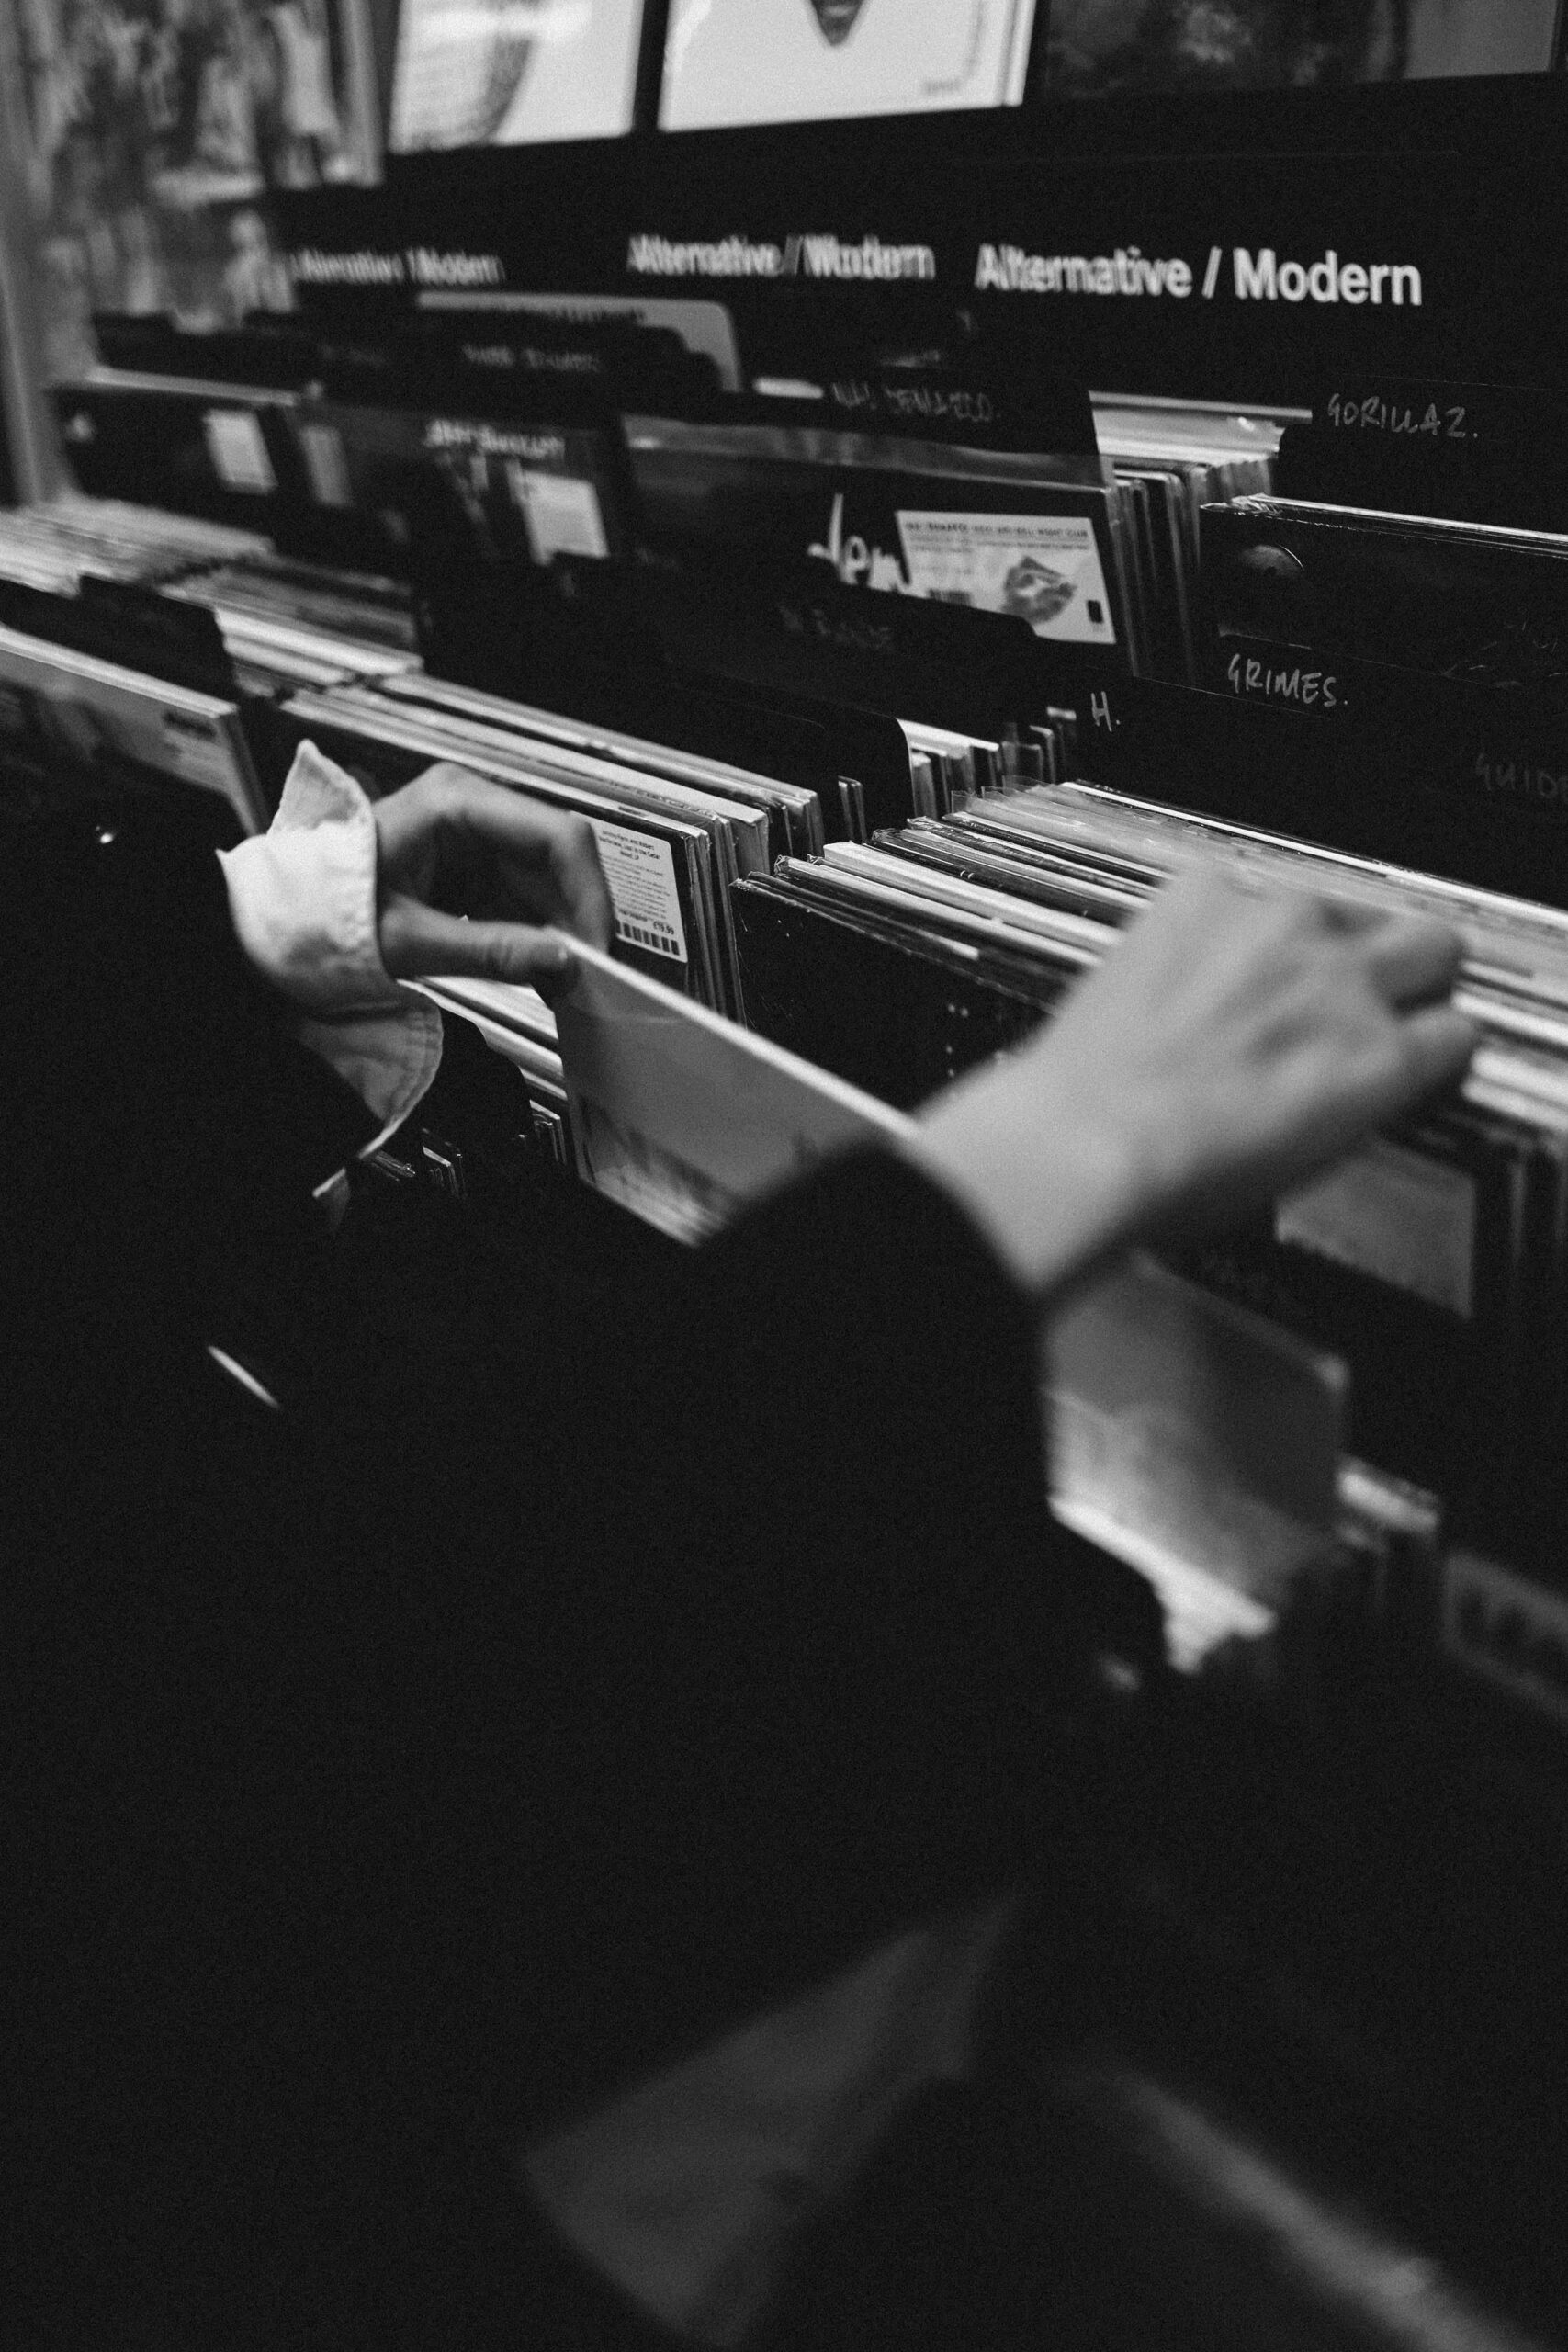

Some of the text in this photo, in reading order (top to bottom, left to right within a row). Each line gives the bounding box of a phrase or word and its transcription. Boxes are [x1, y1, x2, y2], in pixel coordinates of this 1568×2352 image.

[974, 243, 1423, 306] Alternative / Modern
[1227, 653, 1348, 707] GRIMES.
